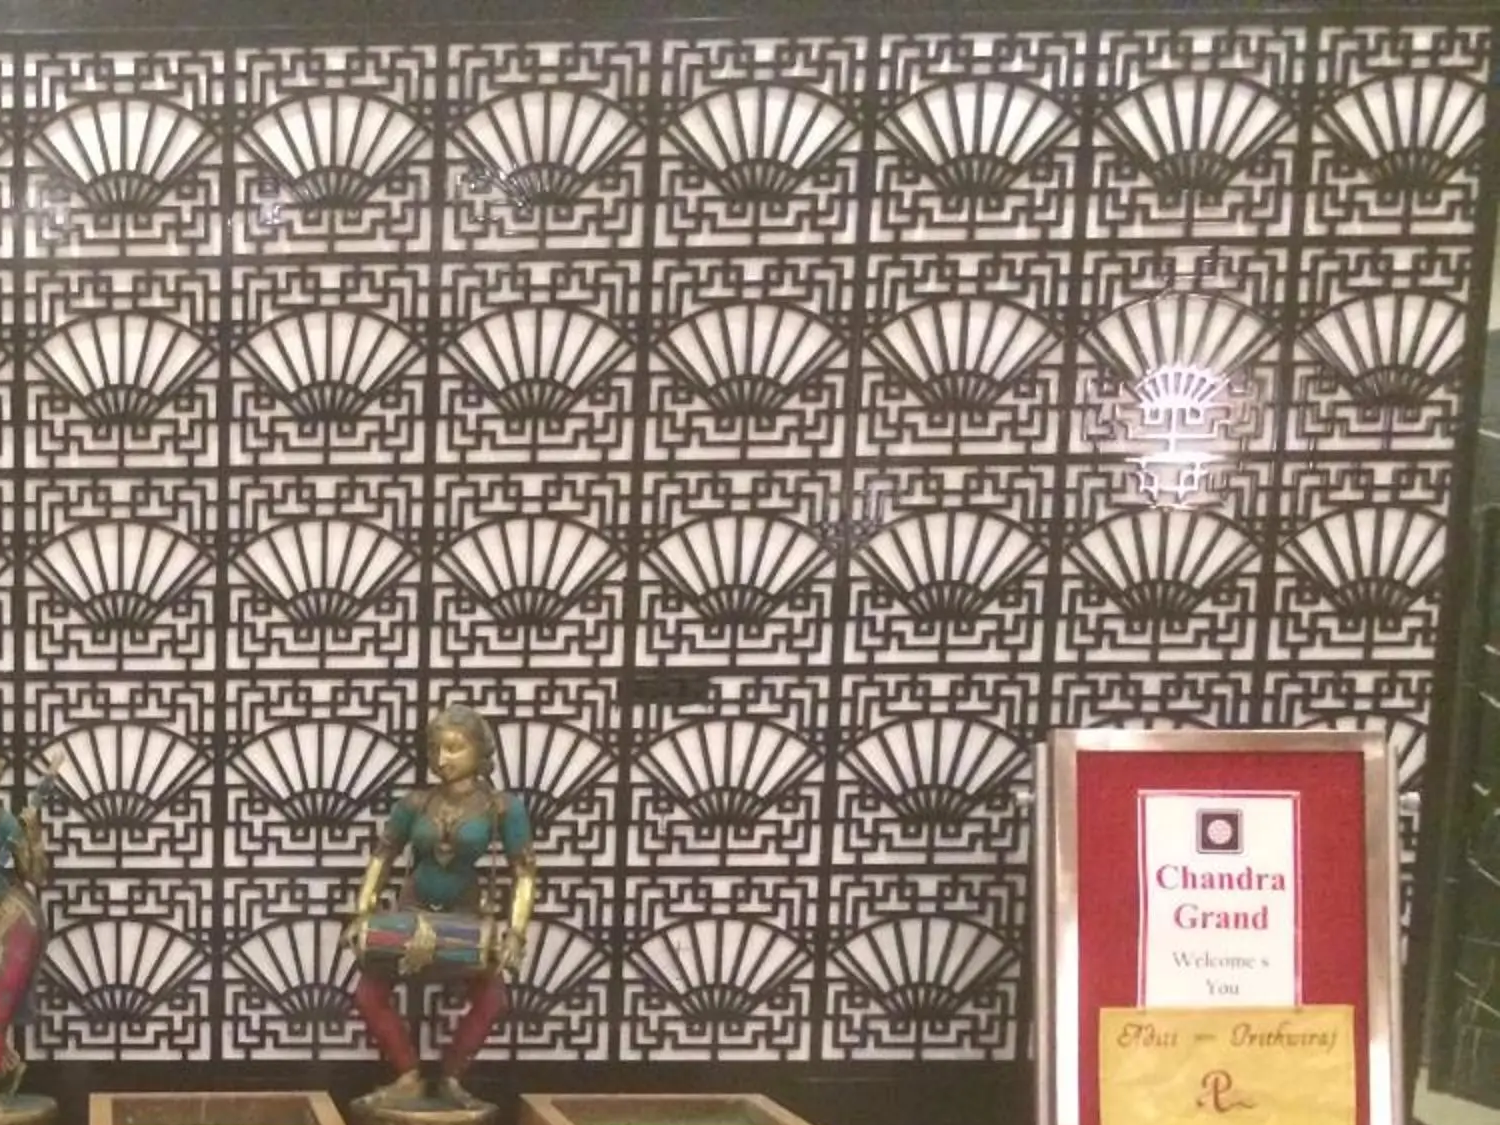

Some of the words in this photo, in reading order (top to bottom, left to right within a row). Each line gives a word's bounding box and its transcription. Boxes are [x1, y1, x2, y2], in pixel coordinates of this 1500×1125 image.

[1156, 864, 1285, 891] Chandra
[1174, 903, 1268, 930] Grand
[1206, 979, 1239, 996] You
